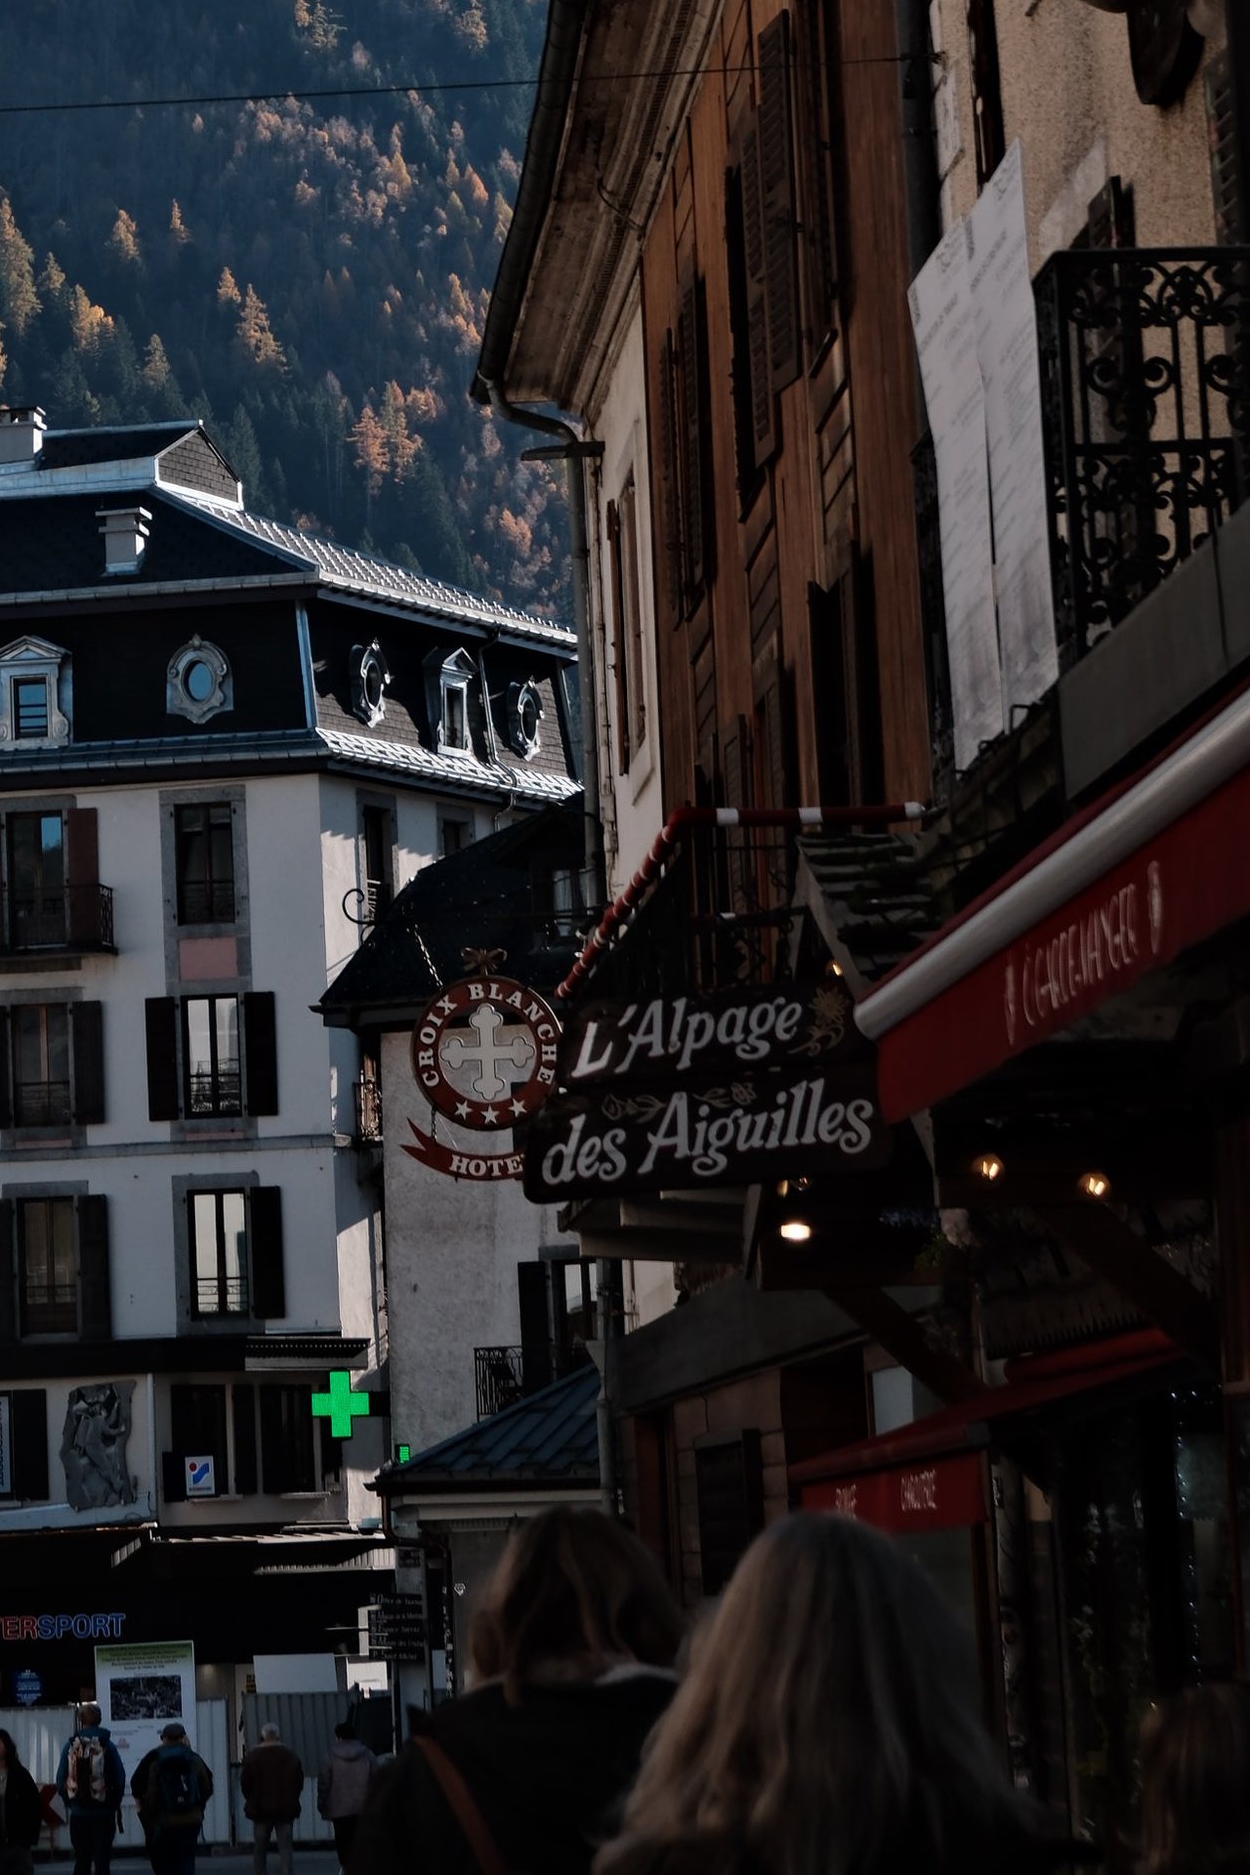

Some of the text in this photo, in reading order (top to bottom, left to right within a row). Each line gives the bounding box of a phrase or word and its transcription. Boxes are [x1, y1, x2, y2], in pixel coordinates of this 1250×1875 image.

[418, 982, 558, 1088] CROIX BLANCHE
[571, 996, 802, 1079] L'Alpage
[449, 1153, 526, 1177] HOTE
[541, 1077, 874, 1185] des Aiguilles
